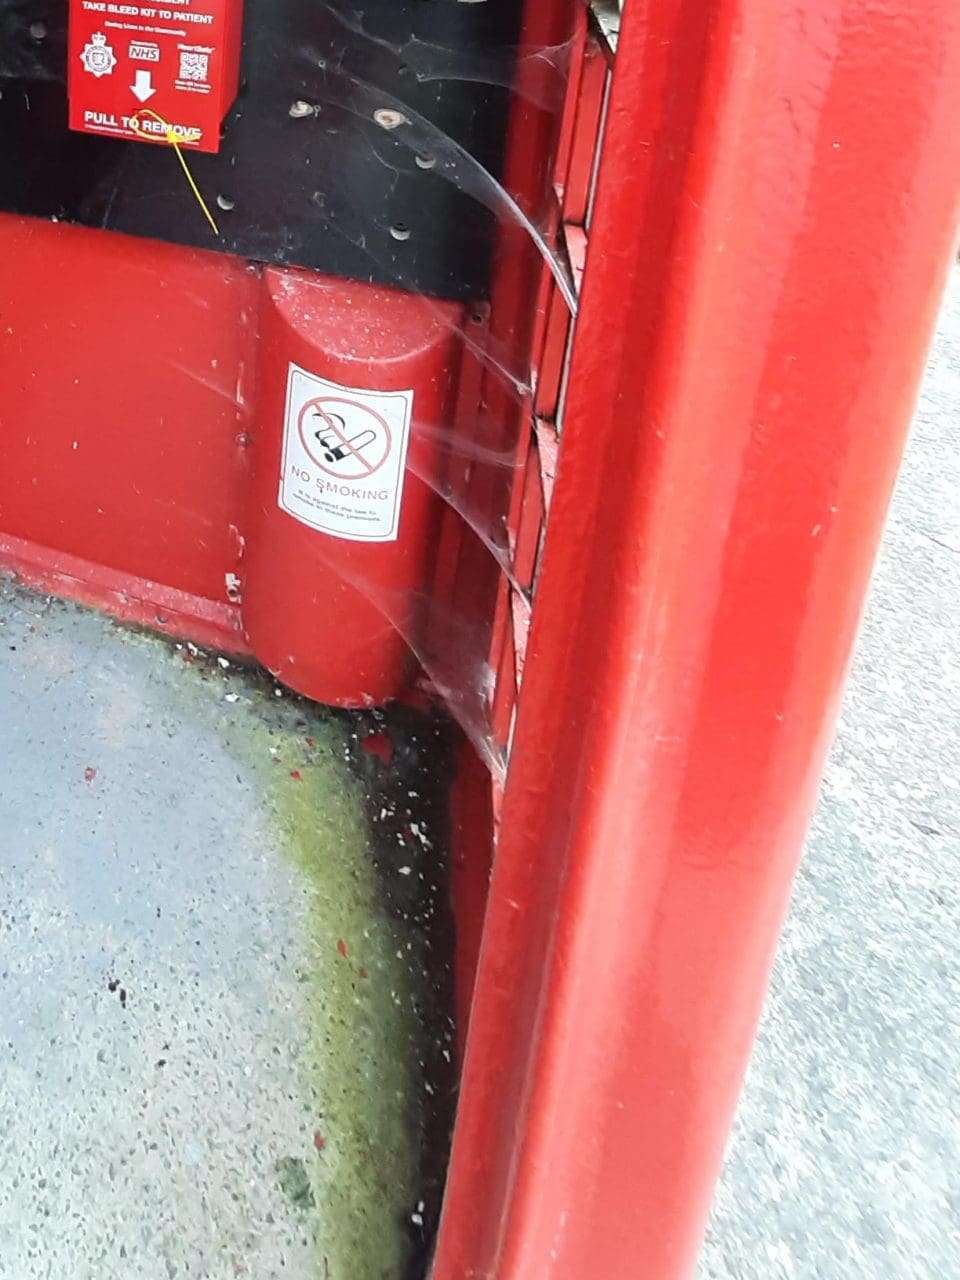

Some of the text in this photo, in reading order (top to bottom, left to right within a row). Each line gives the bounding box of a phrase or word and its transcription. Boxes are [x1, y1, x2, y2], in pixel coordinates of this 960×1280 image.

[82, 0, 214, 24] TAKE BLEED KIT TO PATIENT
[130, 47, 158, 60] NHS
[84, 111, 118, 126] PULL
[121, 116, 139, 129] TO
[142, 120, 202, 138] REMOVE
[291, 465, 389, 500] NO SMOKING
